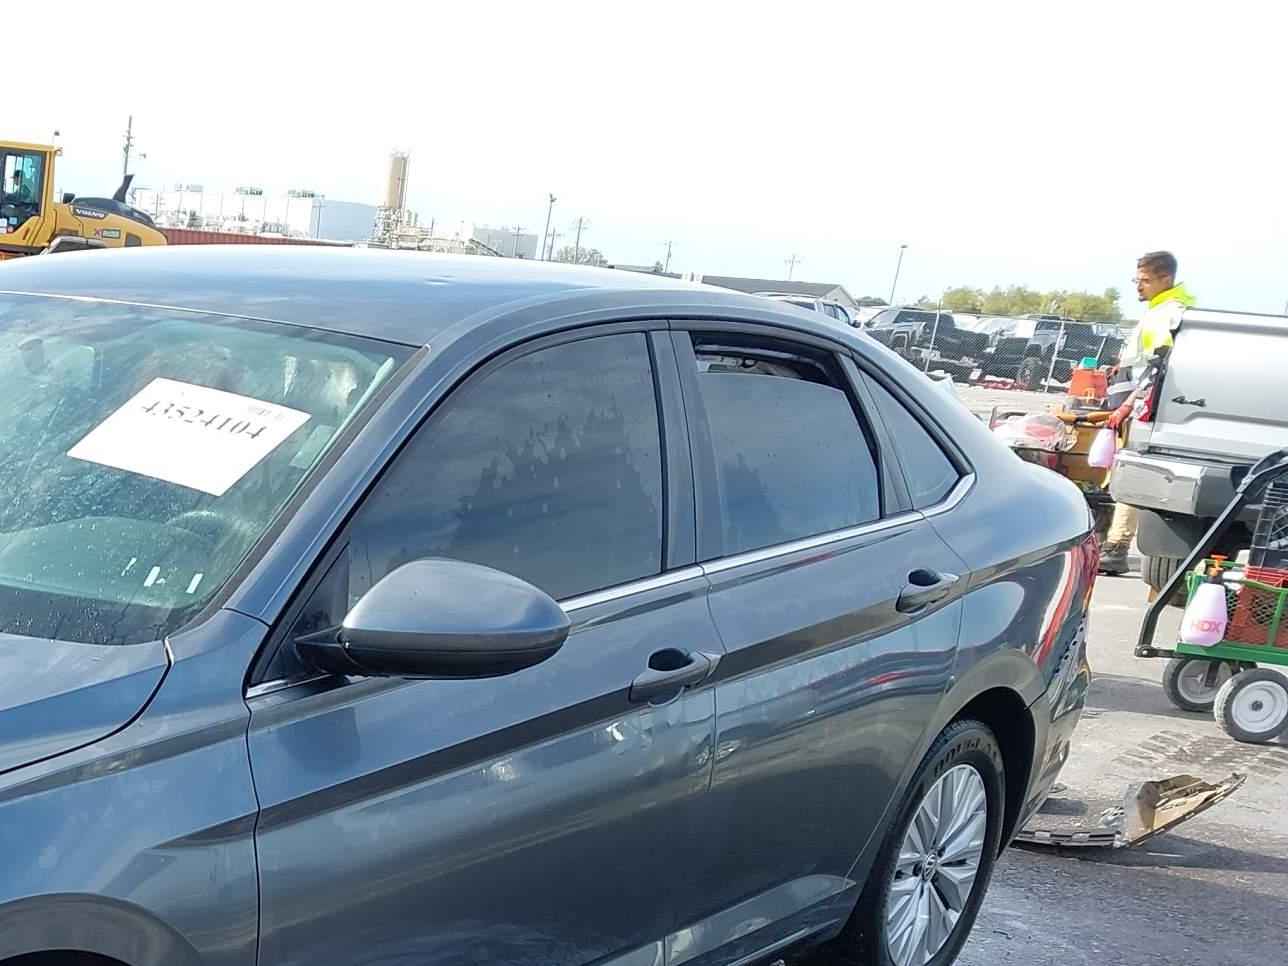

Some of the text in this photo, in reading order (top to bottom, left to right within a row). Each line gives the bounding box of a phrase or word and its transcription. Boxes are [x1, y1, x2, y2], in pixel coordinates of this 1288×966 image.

[75, 209, 105, 218] VOLVO
[142, 401, 267, 440] 43524104
[1192, 620, 1222, 633] HDX
